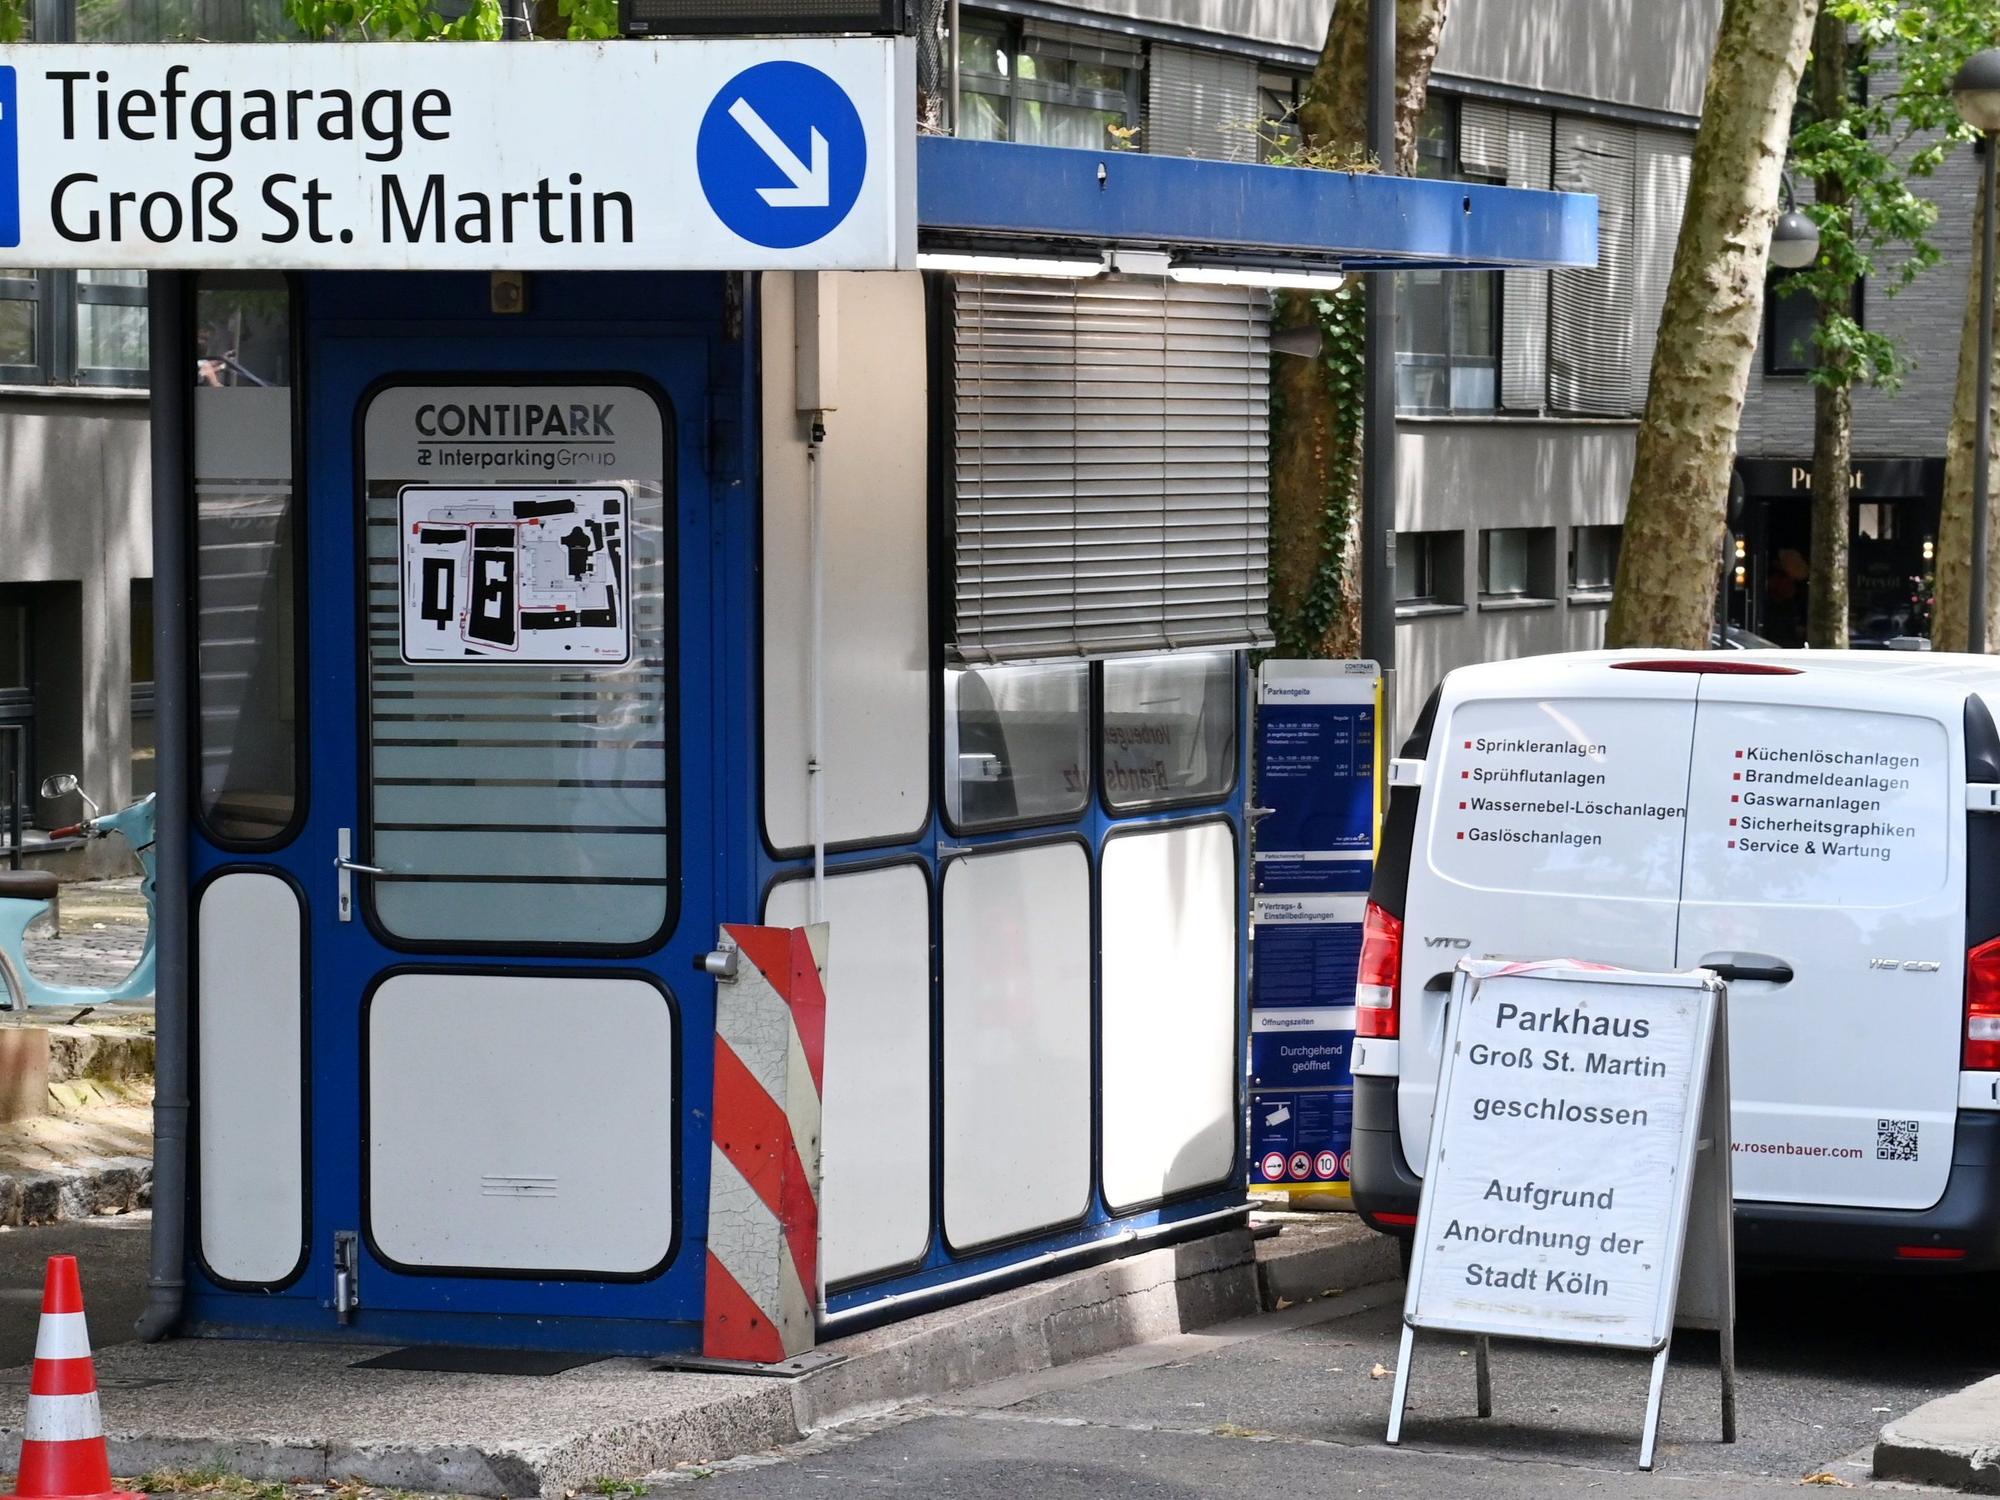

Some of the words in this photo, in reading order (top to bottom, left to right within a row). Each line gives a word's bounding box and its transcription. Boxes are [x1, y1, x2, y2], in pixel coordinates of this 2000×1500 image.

[46, 65, 452, 162] Tiefgarage
[51, 172, 238, 244] Groß
[262, 173, 354, 244] St.
[382, 173, 633, 244] Martin
[415, 404, 615, 436] CONTIPARK
[1792, 467, 1863, 489] Prot
[1476, 738, 1607, 757] Sprinkleranlagen
[1746, 747, 1920, 770] Küchenlöschanlagen
[1473, 767, 1606, 787] Sprühflutanlagen
[1745, 769, 1910, 792] Brandmeldeanlagen
[1470, 798, 1686, 819] Wassernebel-Löschanlagen
[1743, 792, 1881, 813] Gaswarnanlagen
[1468, 827, 1602, 848] Gaslöschanlagen
[1740, 815, 1916, 838] Sicherheitsgraphiken
[1738, 837, 1799, 854] Service
[1804, 840, 1816, 855] &
[1822, 841, 1891, 862] Wartung
[1424, 936, 1472, 949] VITO
[1495, 1002, 1650, 1038] Parkhaus
[1280, 1044, 1343, 1058] Durchgehend
[1469, 1043, 1534, 1069] Groß
[1542, 1050, 1575, 1073] St.
[1586, 1053, 1666, 1077] Martin
[1292, 1060, 1331, 1073] geöffnet
[1473, 1097, 1648, 1126] geschlossen
[1731, 1142, 1863, 1159] w.rosenbauer.com
[1321, 1158, 1332, 1171] 10
[1483, 1179, 1614, 1210] Aufgrund
[1443, 1219, 1591, 1256] Anordnung
[1600, 1232, 1645, 1255] der
[1465, 1263, 1538, 1291] Stadt
[1546, 1269, 1608, 1297] Köln
